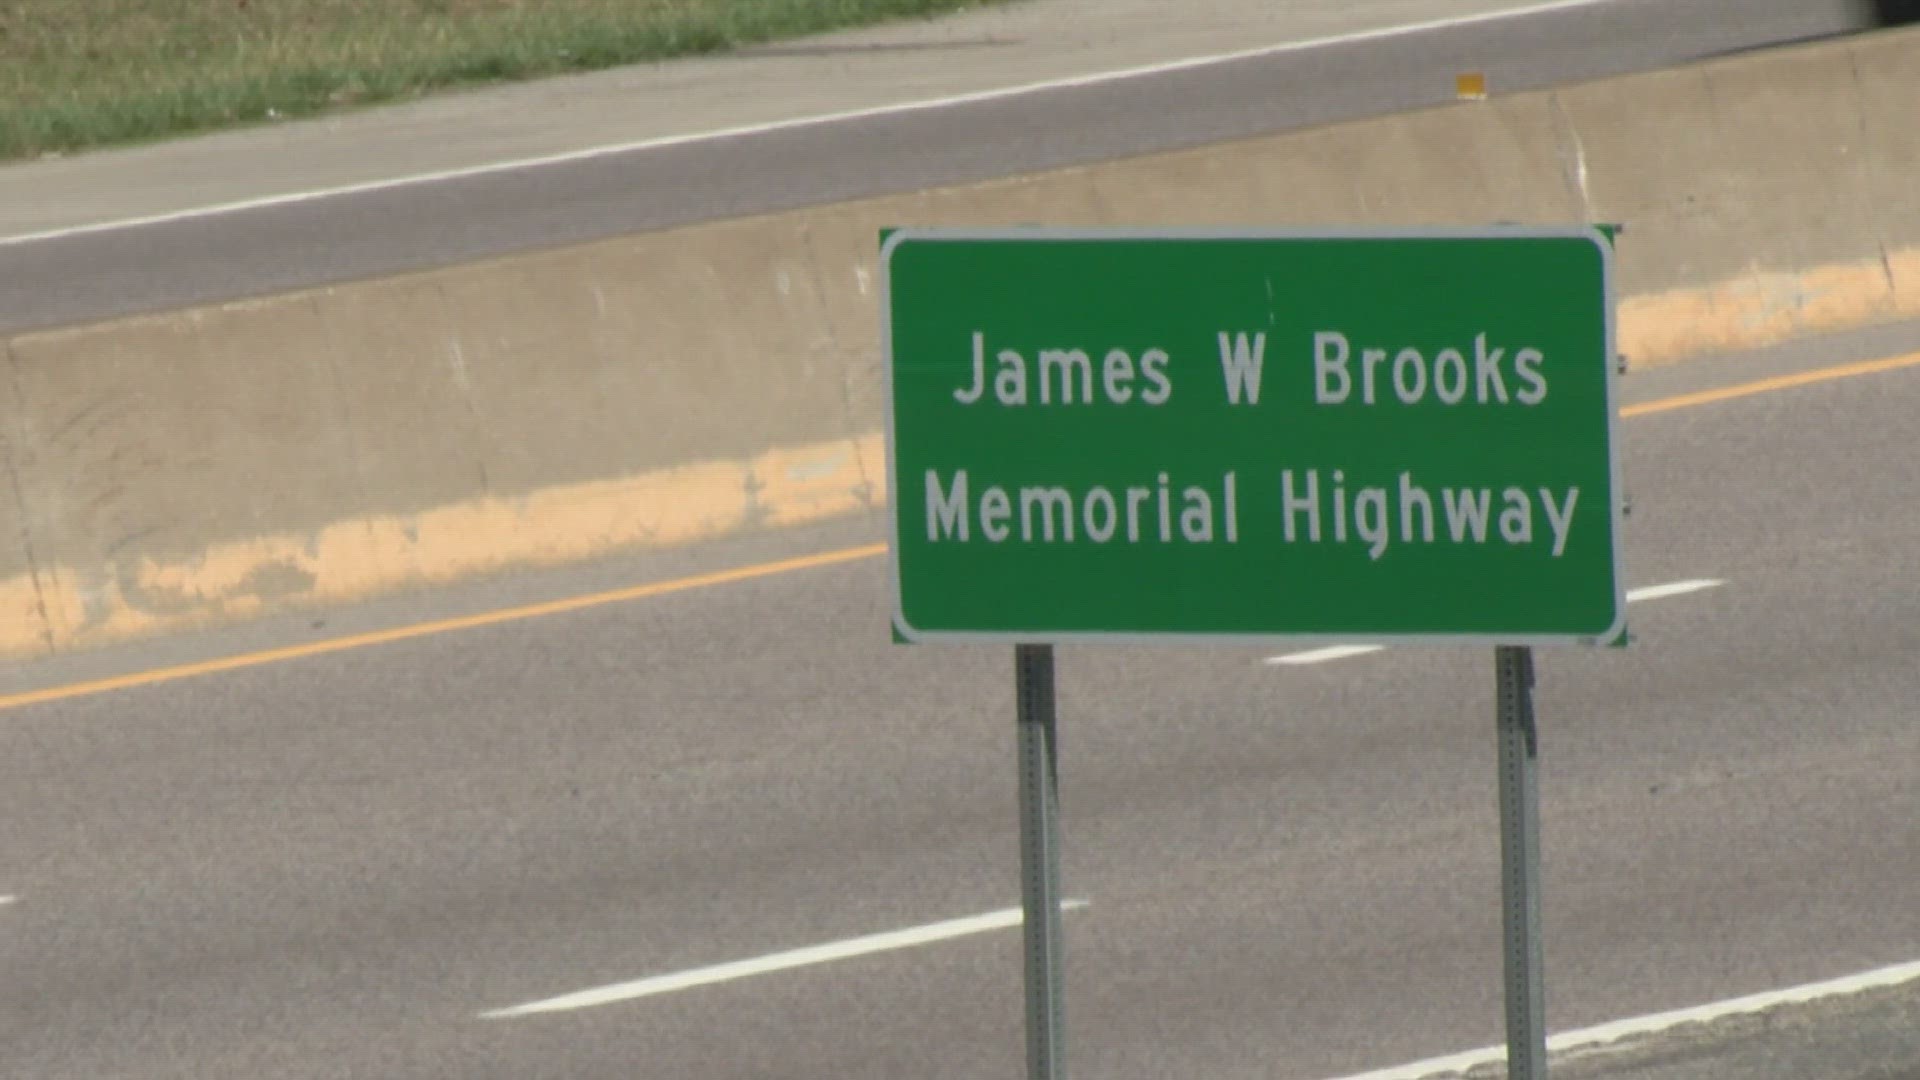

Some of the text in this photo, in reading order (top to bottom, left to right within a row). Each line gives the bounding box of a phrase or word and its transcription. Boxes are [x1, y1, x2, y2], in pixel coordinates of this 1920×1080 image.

[954, 332, 1548, 407] James W Brooks
[925, 470, 1579, 559] Memorial Highway
